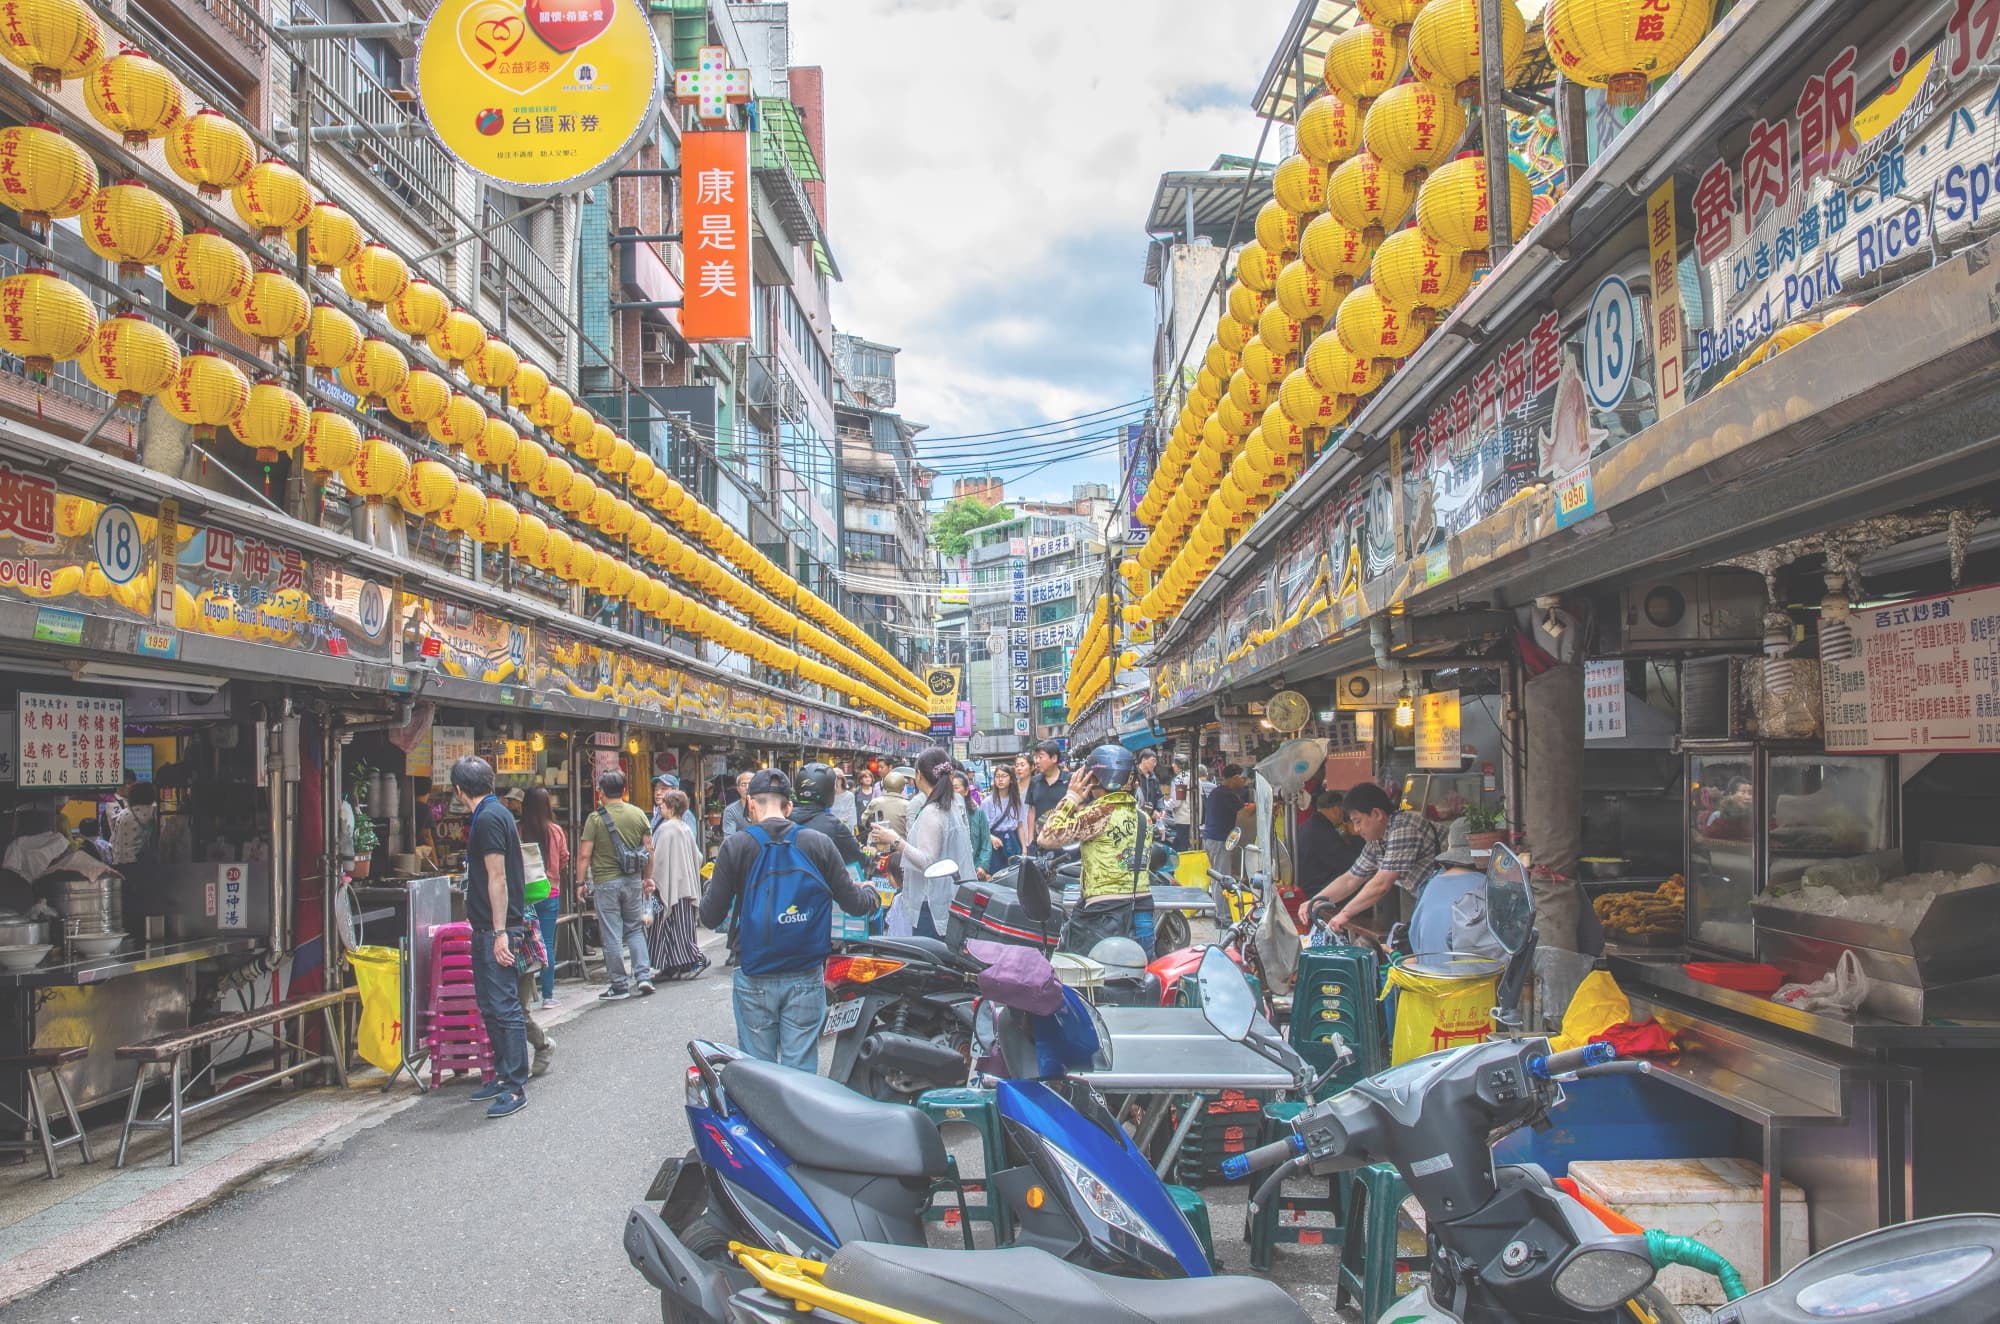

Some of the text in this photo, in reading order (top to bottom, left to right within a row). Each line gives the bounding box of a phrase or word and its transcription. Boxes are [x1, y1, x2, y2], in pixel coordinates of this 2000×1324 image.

[499, 61, 550, 74] 公益彩券
[512, 115, 599, 134] 台灣彩券
[1413, 94, 1436, 151] 開漳聖王
[0, 129, 27, 195] 歡迎光臨
[696, 168, 736, 297] 康是美
[3, 287, 30, 342] 開漳聖王
[1652, 200, 1680, 400] 基隆廟口
[1700, 292, 1772, 372] Braised
[1784, 254, 1841, 320] Pork
[1595, 299, 1623, 388] 13
[1352, 358, 1369, 385] 光臨
[1563, 486, 1584, 512] 1950
[106, 519, 131, 571] 18
[160, 507, 176, 611] 基隆廟口
[206, 526, 303, 589] 四神湯
[205, 599, 229, 622] Dragon
[233, 604, 258, 625] Festival
[364, 591, 378, 628] 20
[1875, 599, 1954, 629] 各式炒類
[148, 636, 168, 649] 1950
[511, 631, 522, 658] 22
[41, 711, 53, 759] 肉粽
[57, 712, 69, 759] 刈包
[94, 714, 105, 769] 豬肚湯
[26, 769, 119, 784] 25 40 45 65 65 55
[228, 870, 239, 879] 20
[225, 882, 240, 926] 四神湯
[777, 912, 808, 925] Costa
